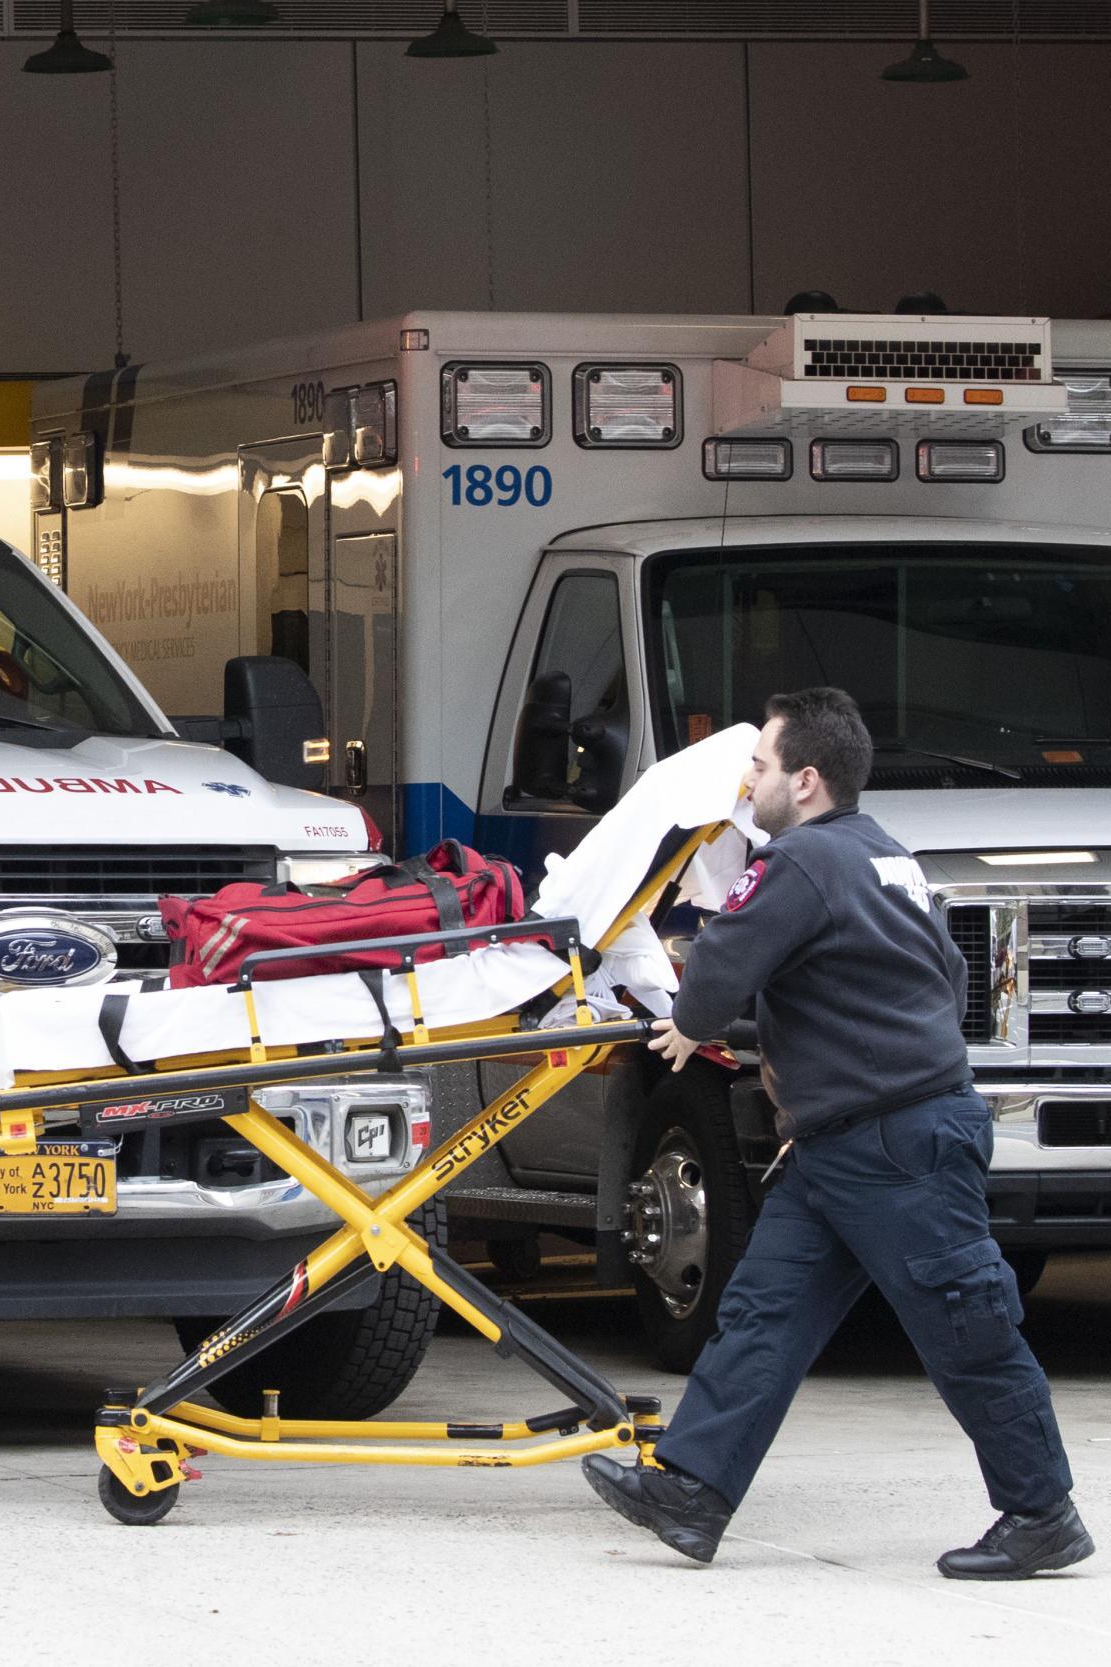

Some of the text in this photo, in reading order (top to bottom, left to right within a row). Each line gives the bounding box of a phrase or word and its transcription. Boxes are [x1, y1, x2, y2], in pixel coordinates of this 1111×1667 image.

[290, 381, 325, 425] 1890
[441, 464, 553, 507] 1890
[162, 636, 195, 659] SERVICES
[303, 825, 349, 838] FA17055
[0, 938, 77, 973] Ford
[101, 1095, 220, 1118] MX-PRO
[43, 1143, 79, 1156] YORK
[9, 1165, 20, 1178] of
[48, 1162, 106, 1199] 3750
[4, 1182, 28, 1195] York
[32, 1201, 55, 1211] NYC
